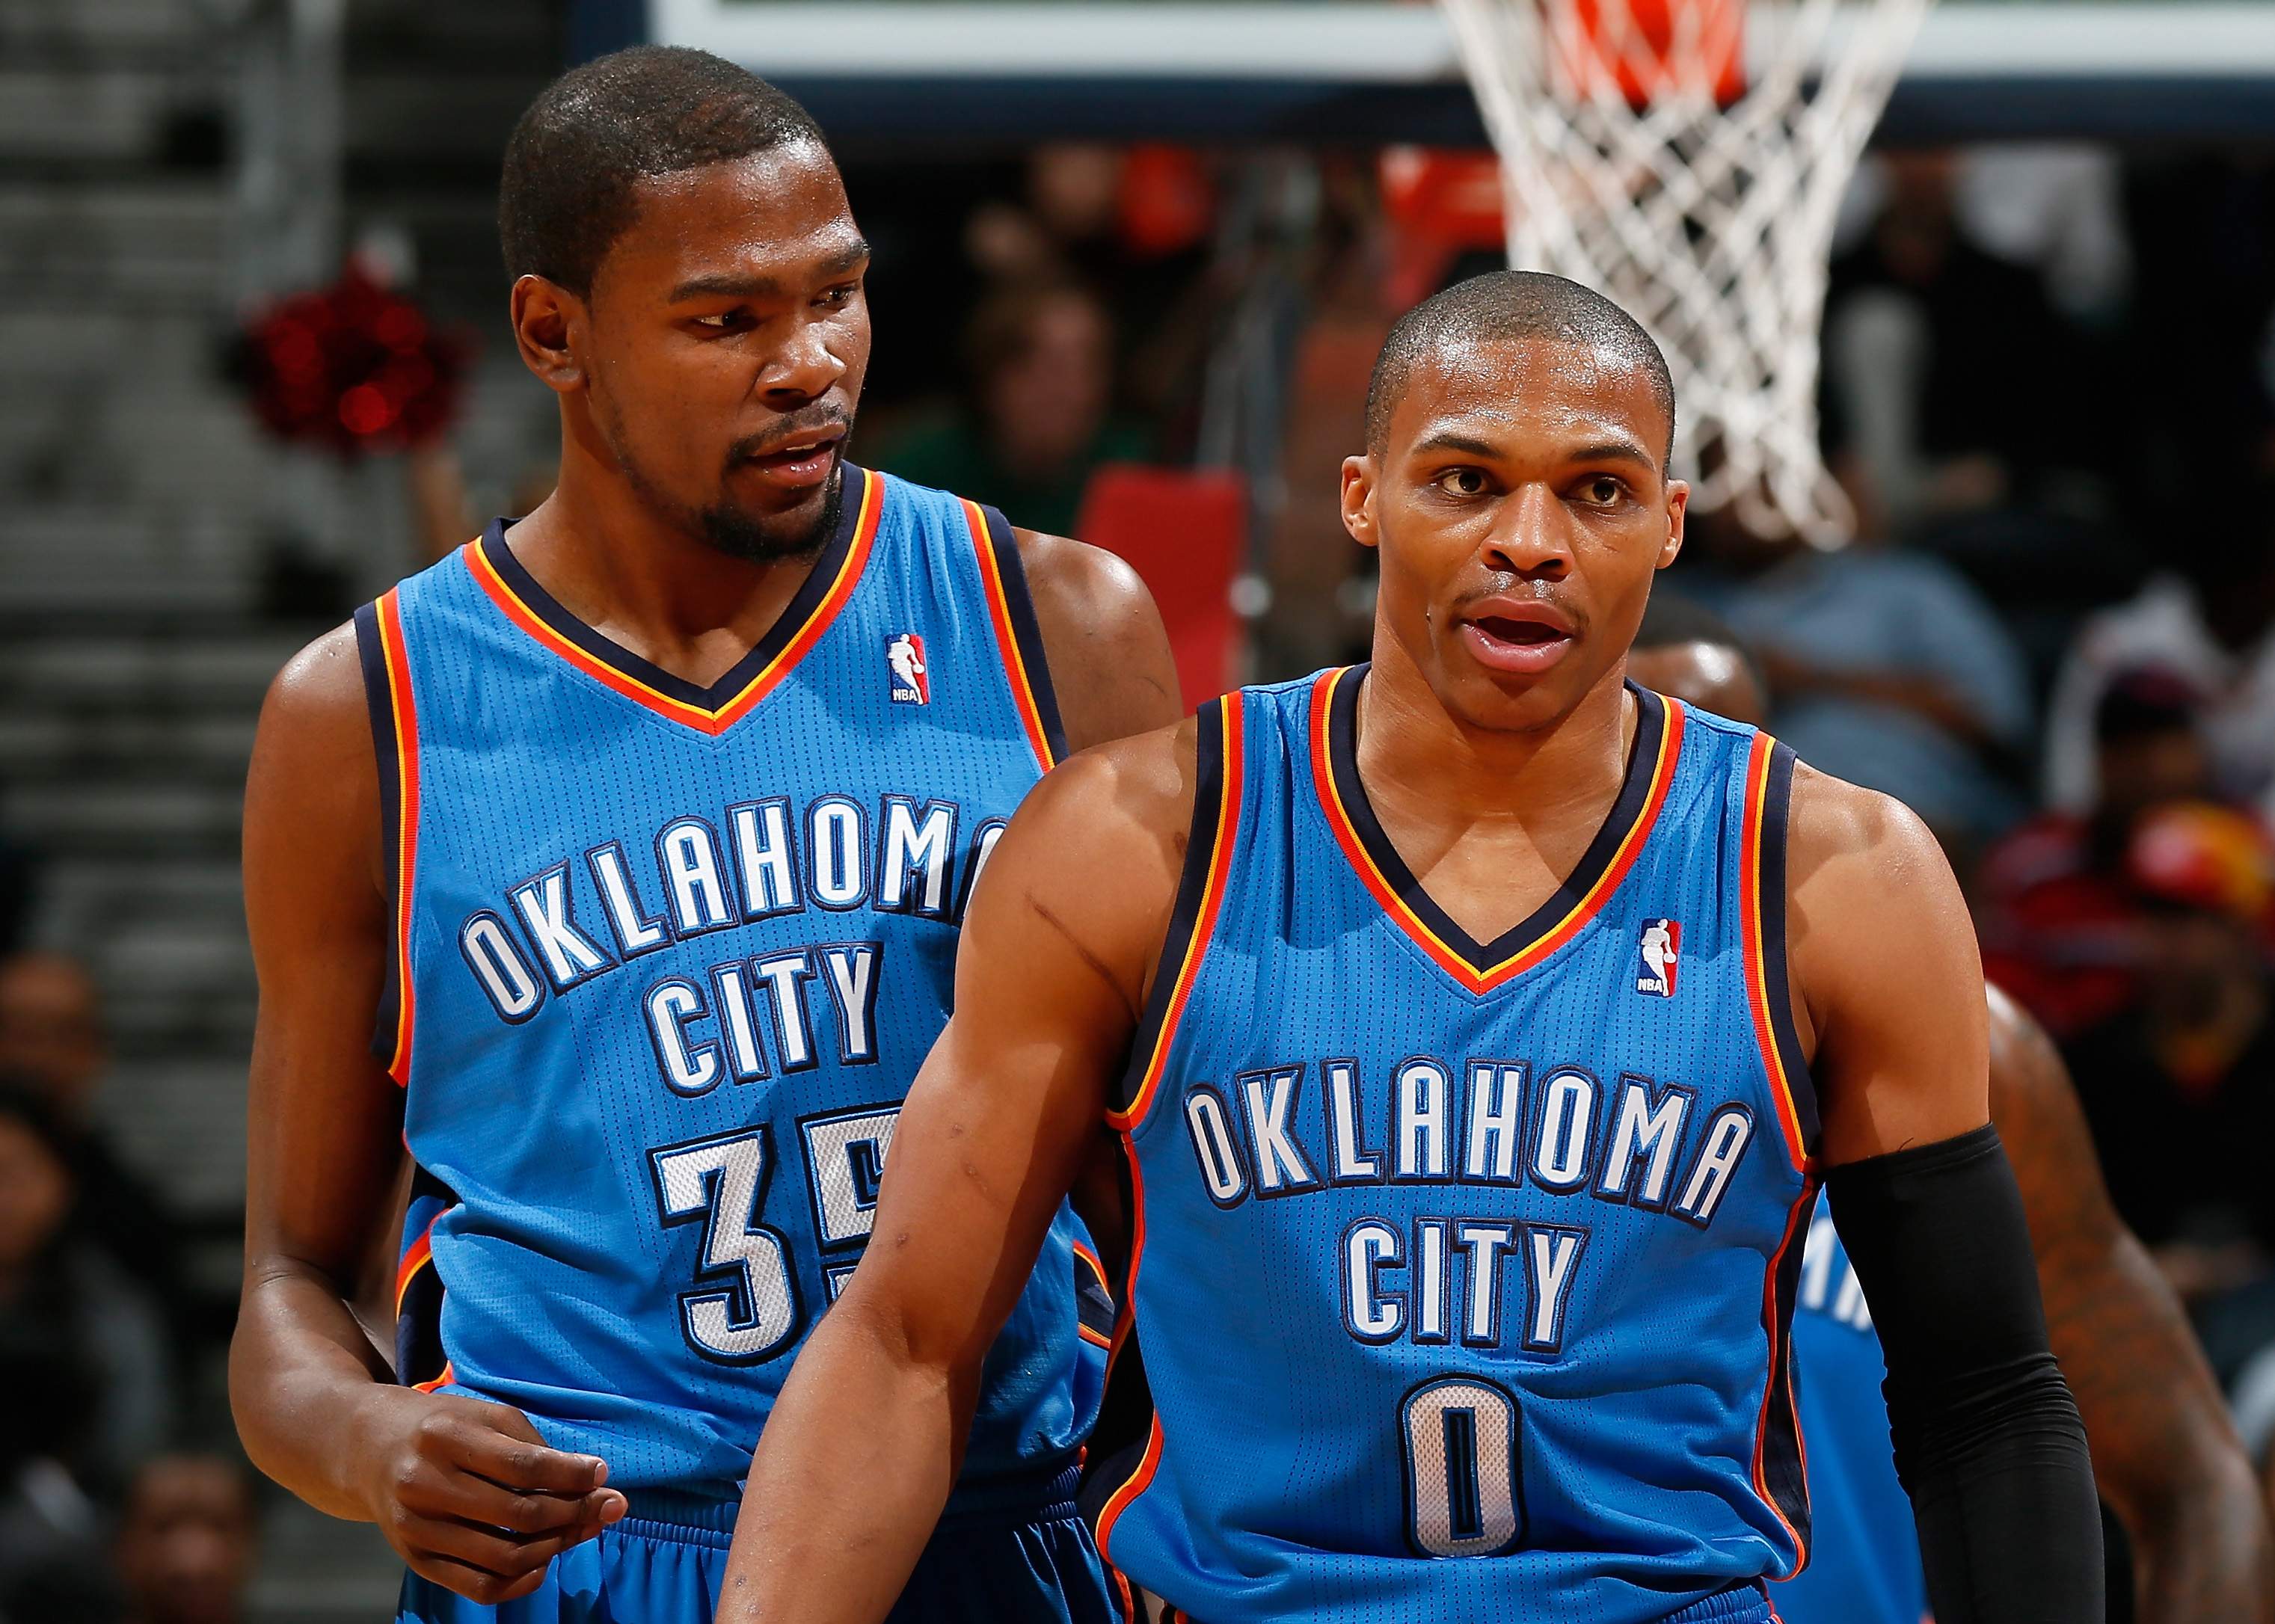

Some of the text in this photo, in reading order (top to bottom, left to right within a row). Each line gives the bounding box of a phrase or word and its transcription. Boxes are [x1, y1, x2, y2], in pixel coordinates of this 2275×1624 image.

[892, 689, 918, 701] NBA
[458, 793, 1008, 1025] OKLAHOM
[1637, 978, 1663, 992] NBA
[642, 941, 883, 1098] CITY
[1183, 1055, 1755, 1231] OKLAHOMA
[1339, 1215, 1591, 1354] CITY
[1396, 1372, 1526, 1560] 0
